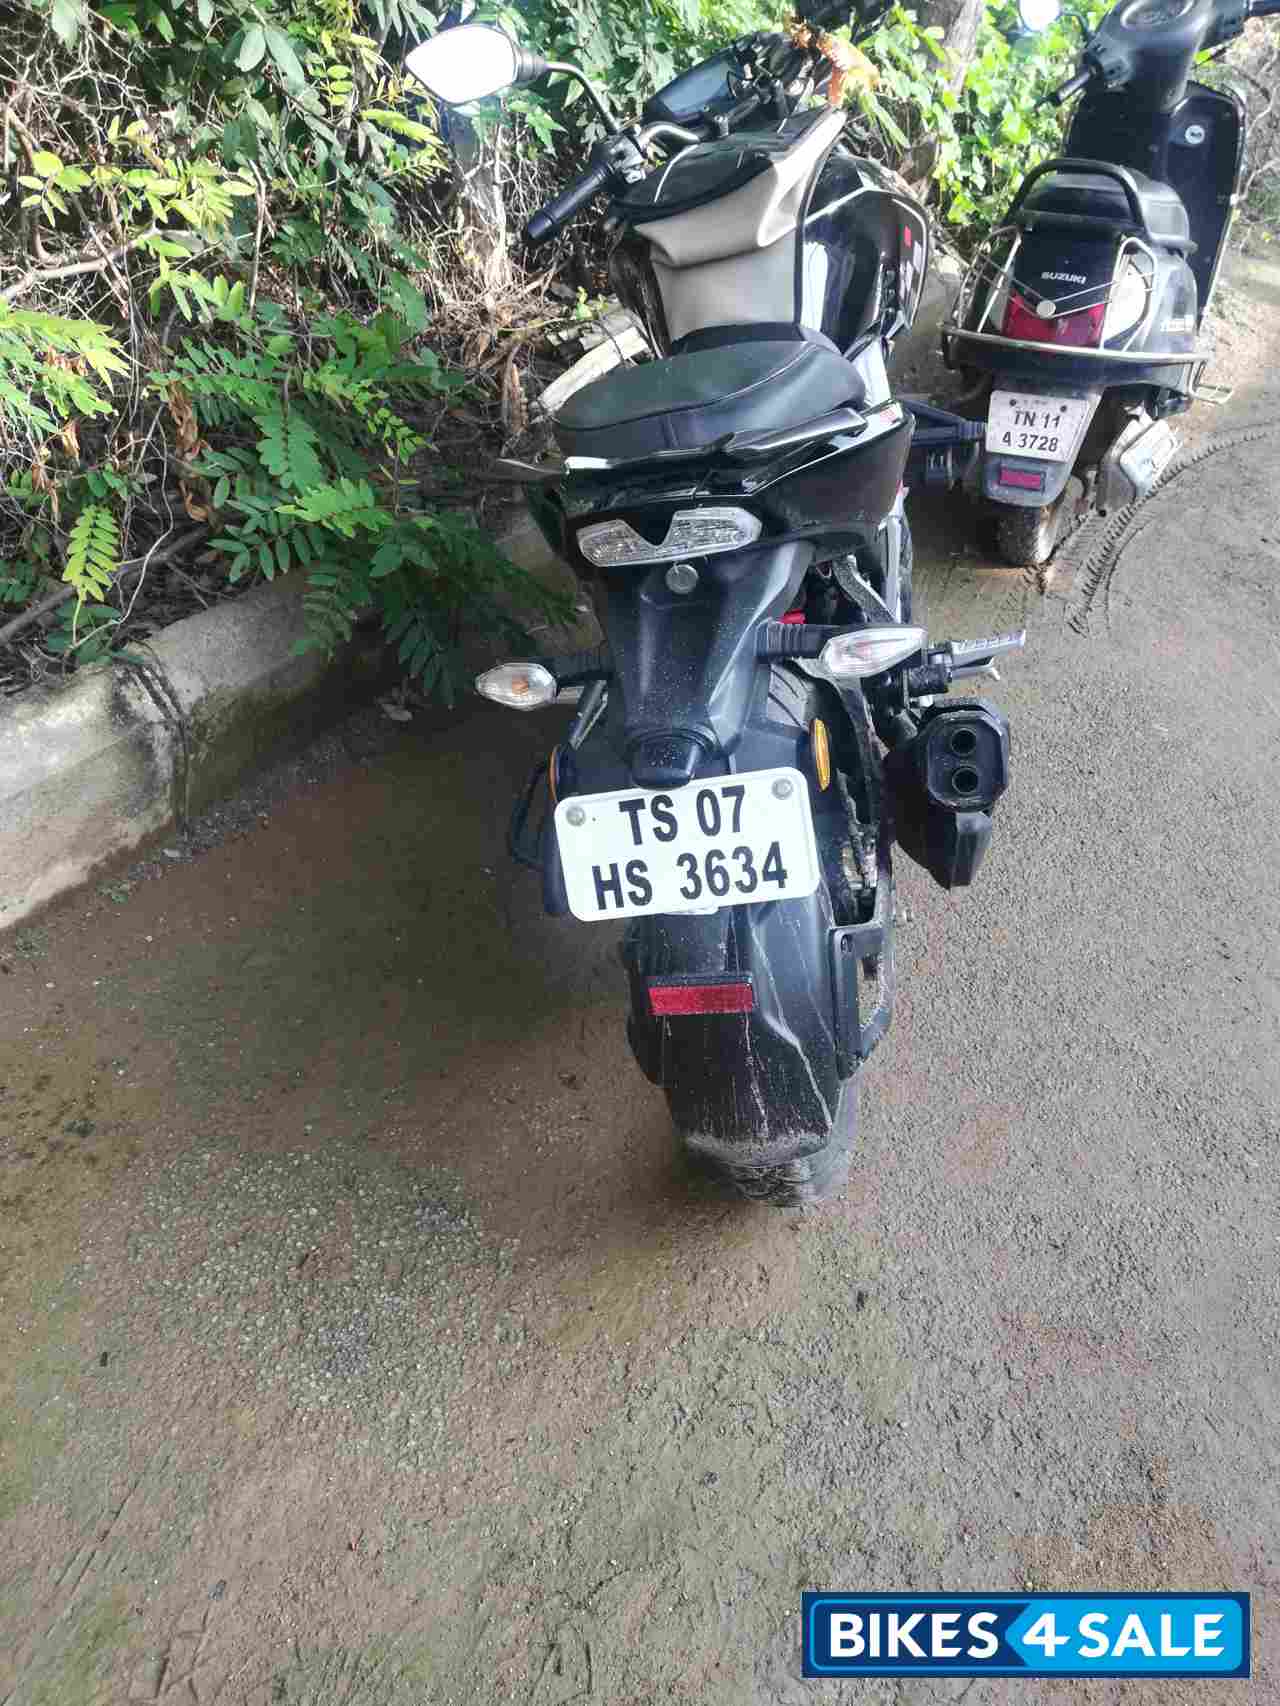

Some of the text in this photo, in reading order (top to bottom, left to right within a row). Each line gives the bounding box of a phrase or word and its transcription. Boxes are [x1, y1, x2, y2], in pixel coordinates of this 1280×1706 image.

[1041, 271, 1087, 285] SUZUKI
[1014, 410, 1060, 428] TN 11
[1019, 433, 1058, 452] 3728
[619, 785, 745, 846] TS 07
[592, 841, 788, 910] HS 3634
